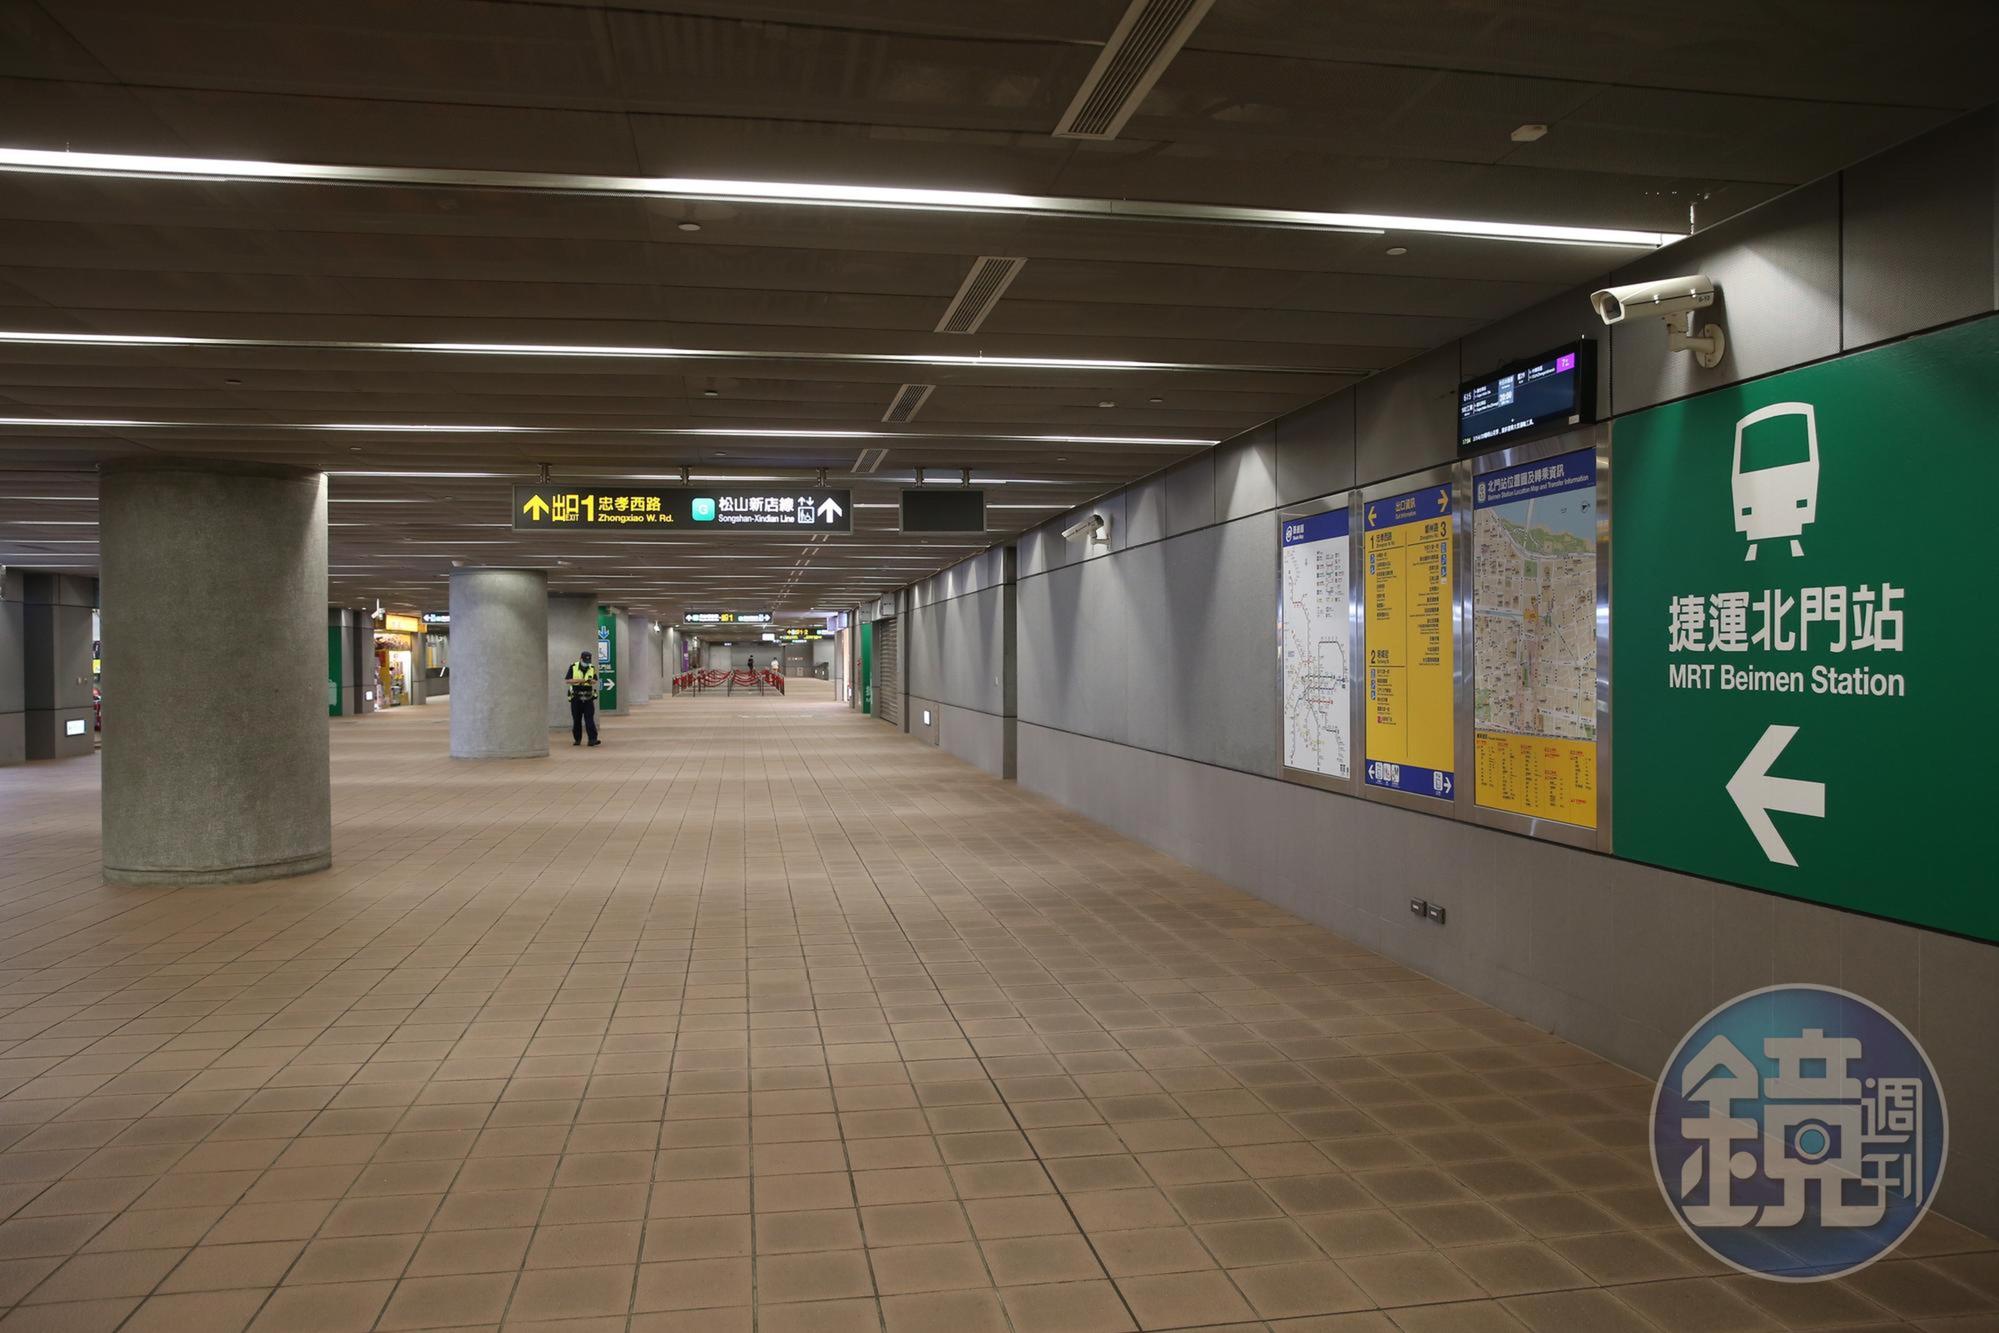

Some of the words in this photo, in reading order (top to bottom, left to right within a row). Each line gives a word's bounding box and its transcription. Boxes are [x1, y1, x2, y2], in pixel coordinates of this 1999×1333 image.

[598, 496, 661, 512] 忠孝西路
[718, 496, 795, 512] 松山新店線
[598, 514, 645, 524] Zhongxiao
[646, 514, 657, 522] W.
[659, 514, 674, 522] Rd.
[718, 514, 779, 524] Songshan-Xindian
[780, 514, 795, 523] Line
[1440, 521, 1447, 537] 3
[1370, 536, 1375, 549] 1
[1668, 583, 1904, 652] 捷運北門站
[1370, 650, 1376, 664] 2
[1669, 664, 1714, 689] MRT
[1720, 665, 1803, 692] Beimen
[1811, 665, 1904, 697] Station
